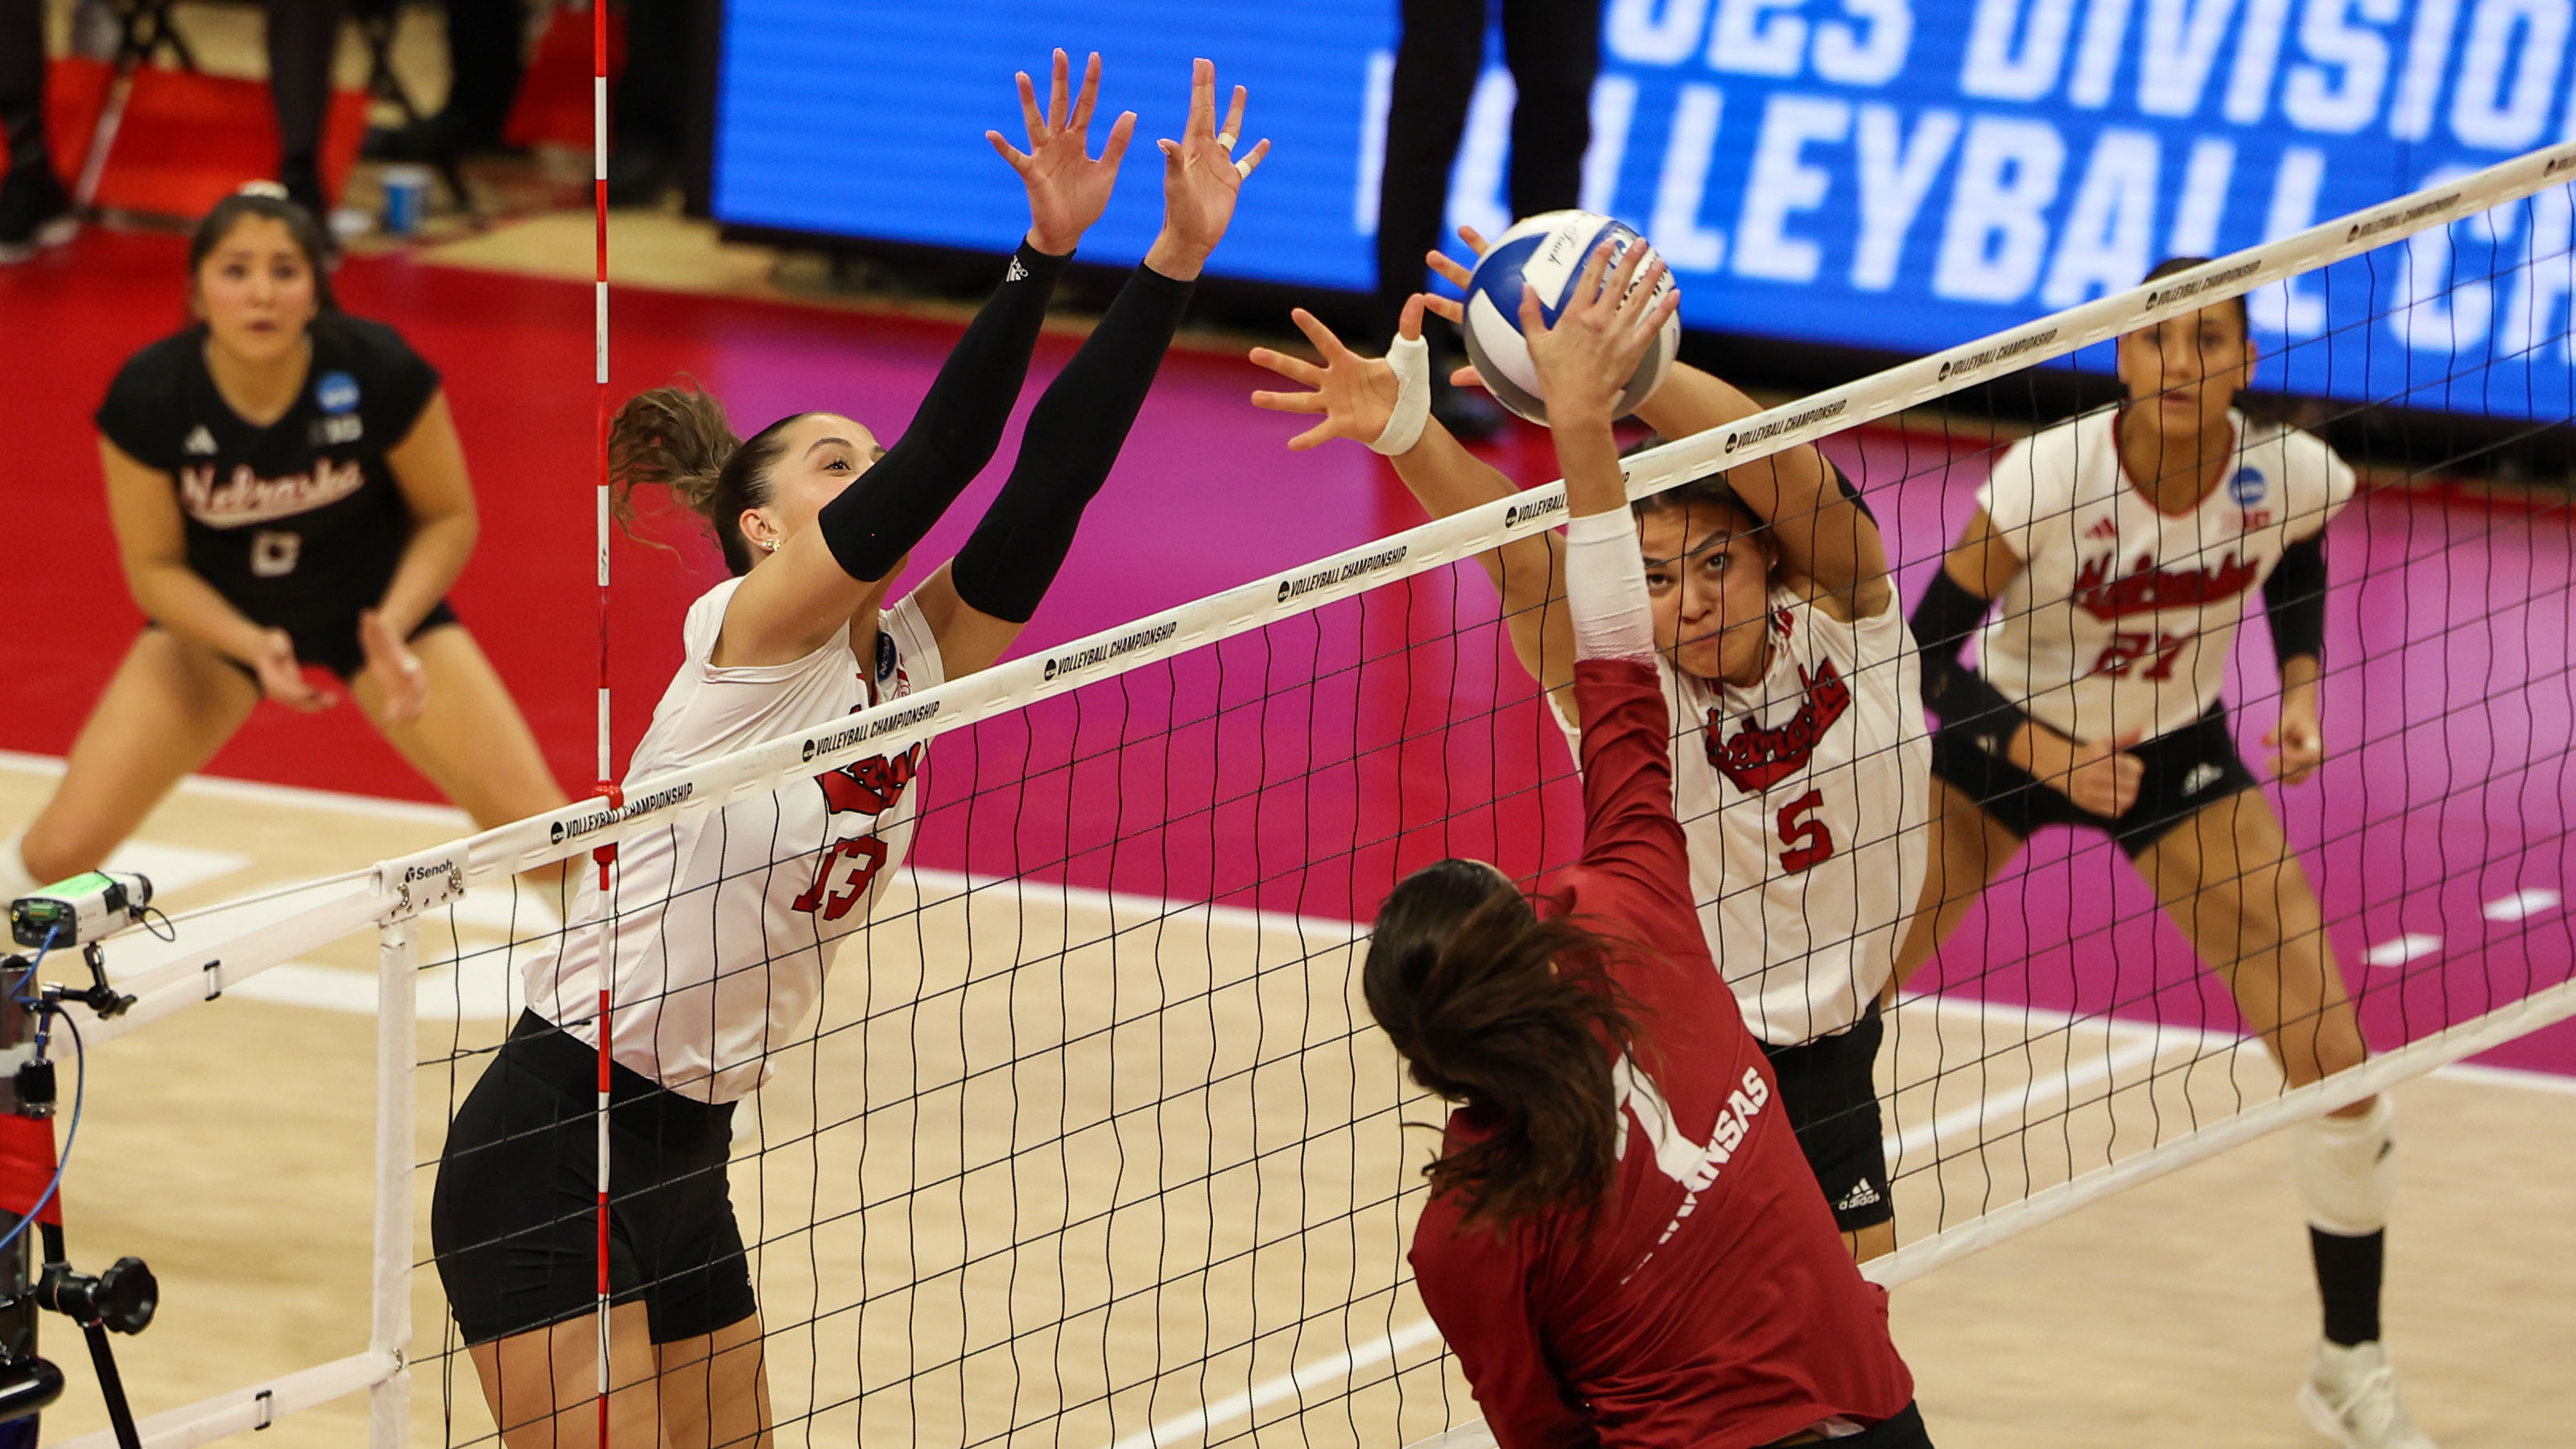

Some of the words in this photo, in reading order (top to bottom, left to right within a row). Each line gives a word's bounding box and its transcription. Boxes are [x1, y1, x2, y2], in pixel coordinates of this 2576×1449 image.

[1960, 0, 2576, 151] DIVISIO
[1950, 349, 1997, 377] VOLLEYBALL
[1736, 420, 1784, 448] VOLLEYBALL
[1784, 399, 1847, 433] CHAMPIONSHIP
[1517, 493, 1566, 522] VOLLEYBALL
[1290, 567, 1340, 597] VOLLEYBALL
[1340, 545, 1407, 581] CHAMPIONSHIP
[1057, 645, 1108, 676] VOLLEYBALL
[1109, 621, 1178, 658] CHAMPIONSHIP
[816, 723, 869, 757] VOLLEYBALL
[870, 700, 940, 738] CHAMPIONSHIP
[566, 808, 620, 839] VOLLEYBALL
[623, 782, 694, 821] CHAMPIONSHIP
[1776, 788, 1835, 877] 5
[416, 858, 452, 880] Senoh
[791, 836, 889, 921] 13
[1838, 1191, 1880, 1211] adidas
